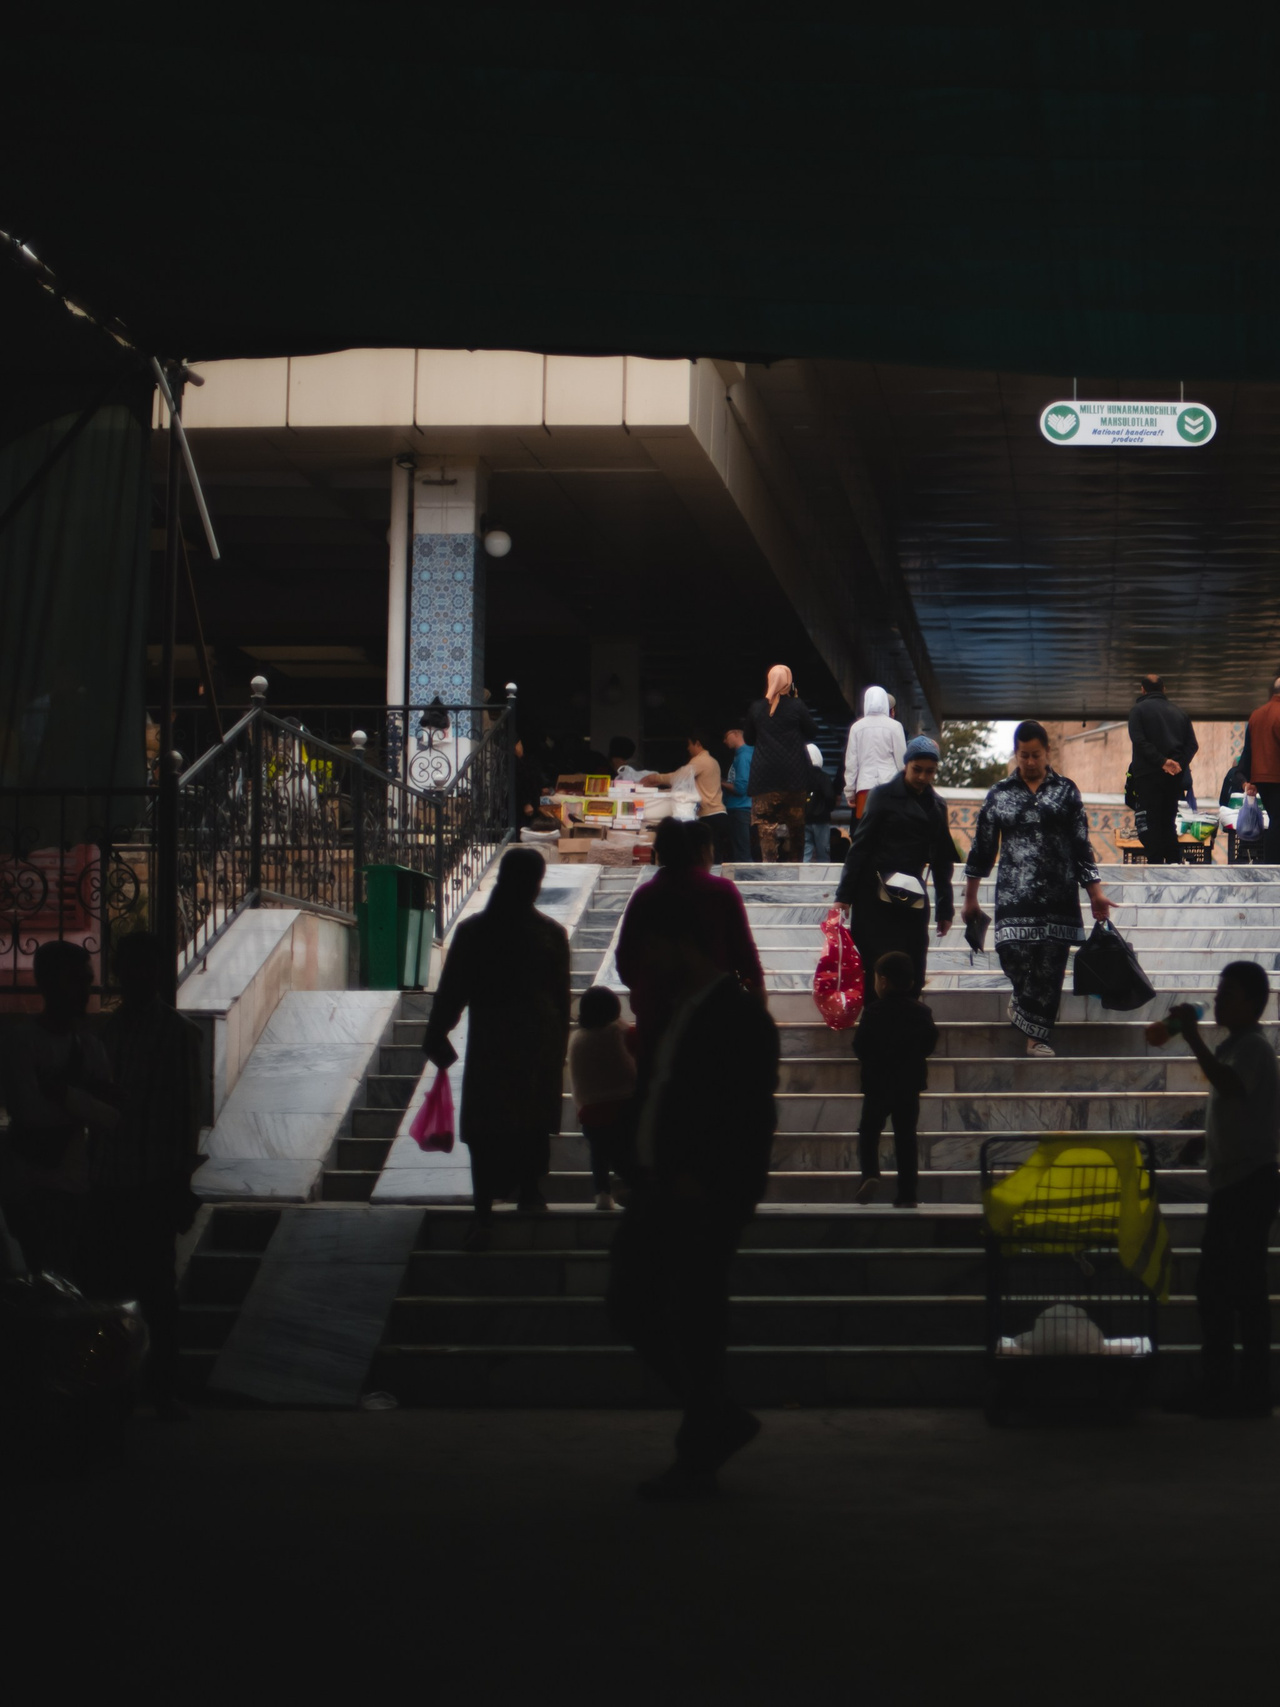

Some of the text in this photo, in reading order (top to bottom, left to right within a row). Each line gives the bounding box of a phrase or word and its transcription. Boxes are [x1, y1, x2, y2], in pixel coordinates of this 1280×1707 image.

[1080, 404, 1177, 415] MILLIY HUNARMANDCHILIK
[1100, 417, 1157, 427] MAHSULOTLARI
[1092, 428, 1124, 436] National
[1111, 436, 1144, 444] products
[1020, 927, 1046, 940] DIOR
